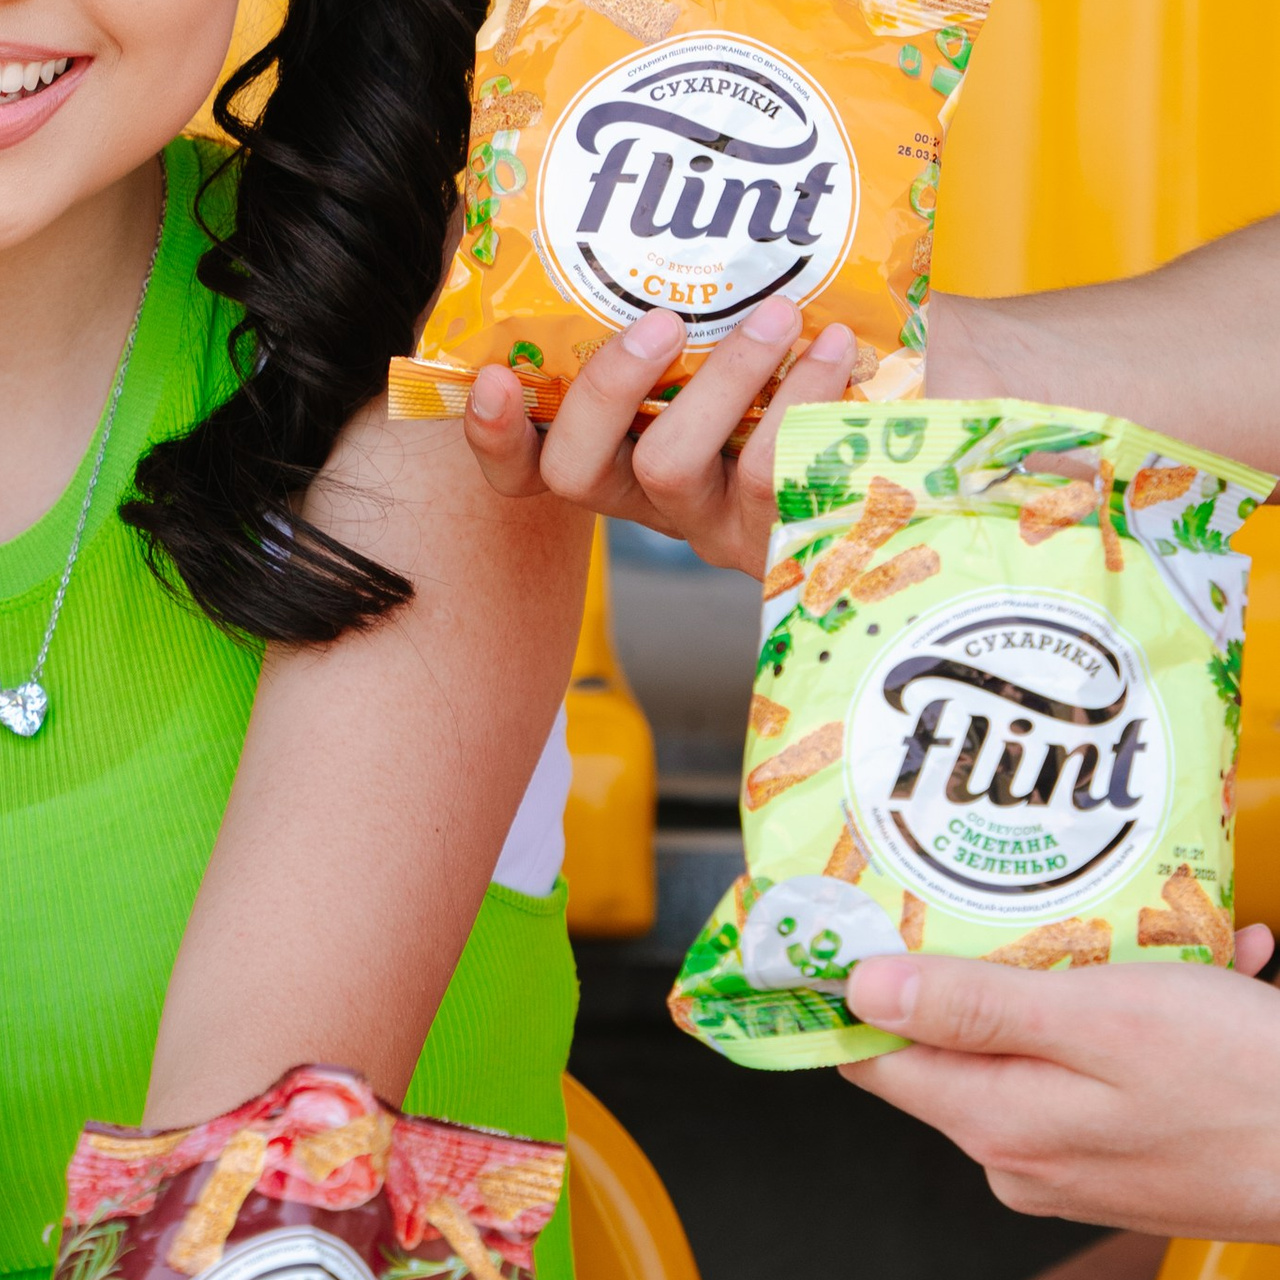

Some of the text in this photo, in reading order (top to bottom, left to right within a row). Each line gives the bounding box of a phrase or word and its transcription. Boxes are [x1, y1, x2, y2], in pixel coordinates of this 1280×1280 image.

[627, 54, 668, 77] СУХАРИКИ
[752, 54, 763, 64] СО
[763, 58, 794, 84] ВКУСОМ
[792, 81, 811, 102] СЫРА
[649, 76, 783, 120] СУХАРИКИ
[576, 138, 839, 246] flint
[647, 252, 725, 275] СО ВКУСОМ
[643, 275, 719, 305] СЫР
[610, 304, 627, 318] БАР
[964, 631, 1104, 679] СУХАРИКИ
[889, 698, 1148, 811] flint
[948, 819, 1059, 855] СМЕТАНА
[967, 811, 1043, 837] СО ВКУСОМ
[933, 835, 950, 852] С
[953, 850, 1068, 875] ЗЕЛЕНЬЮ
